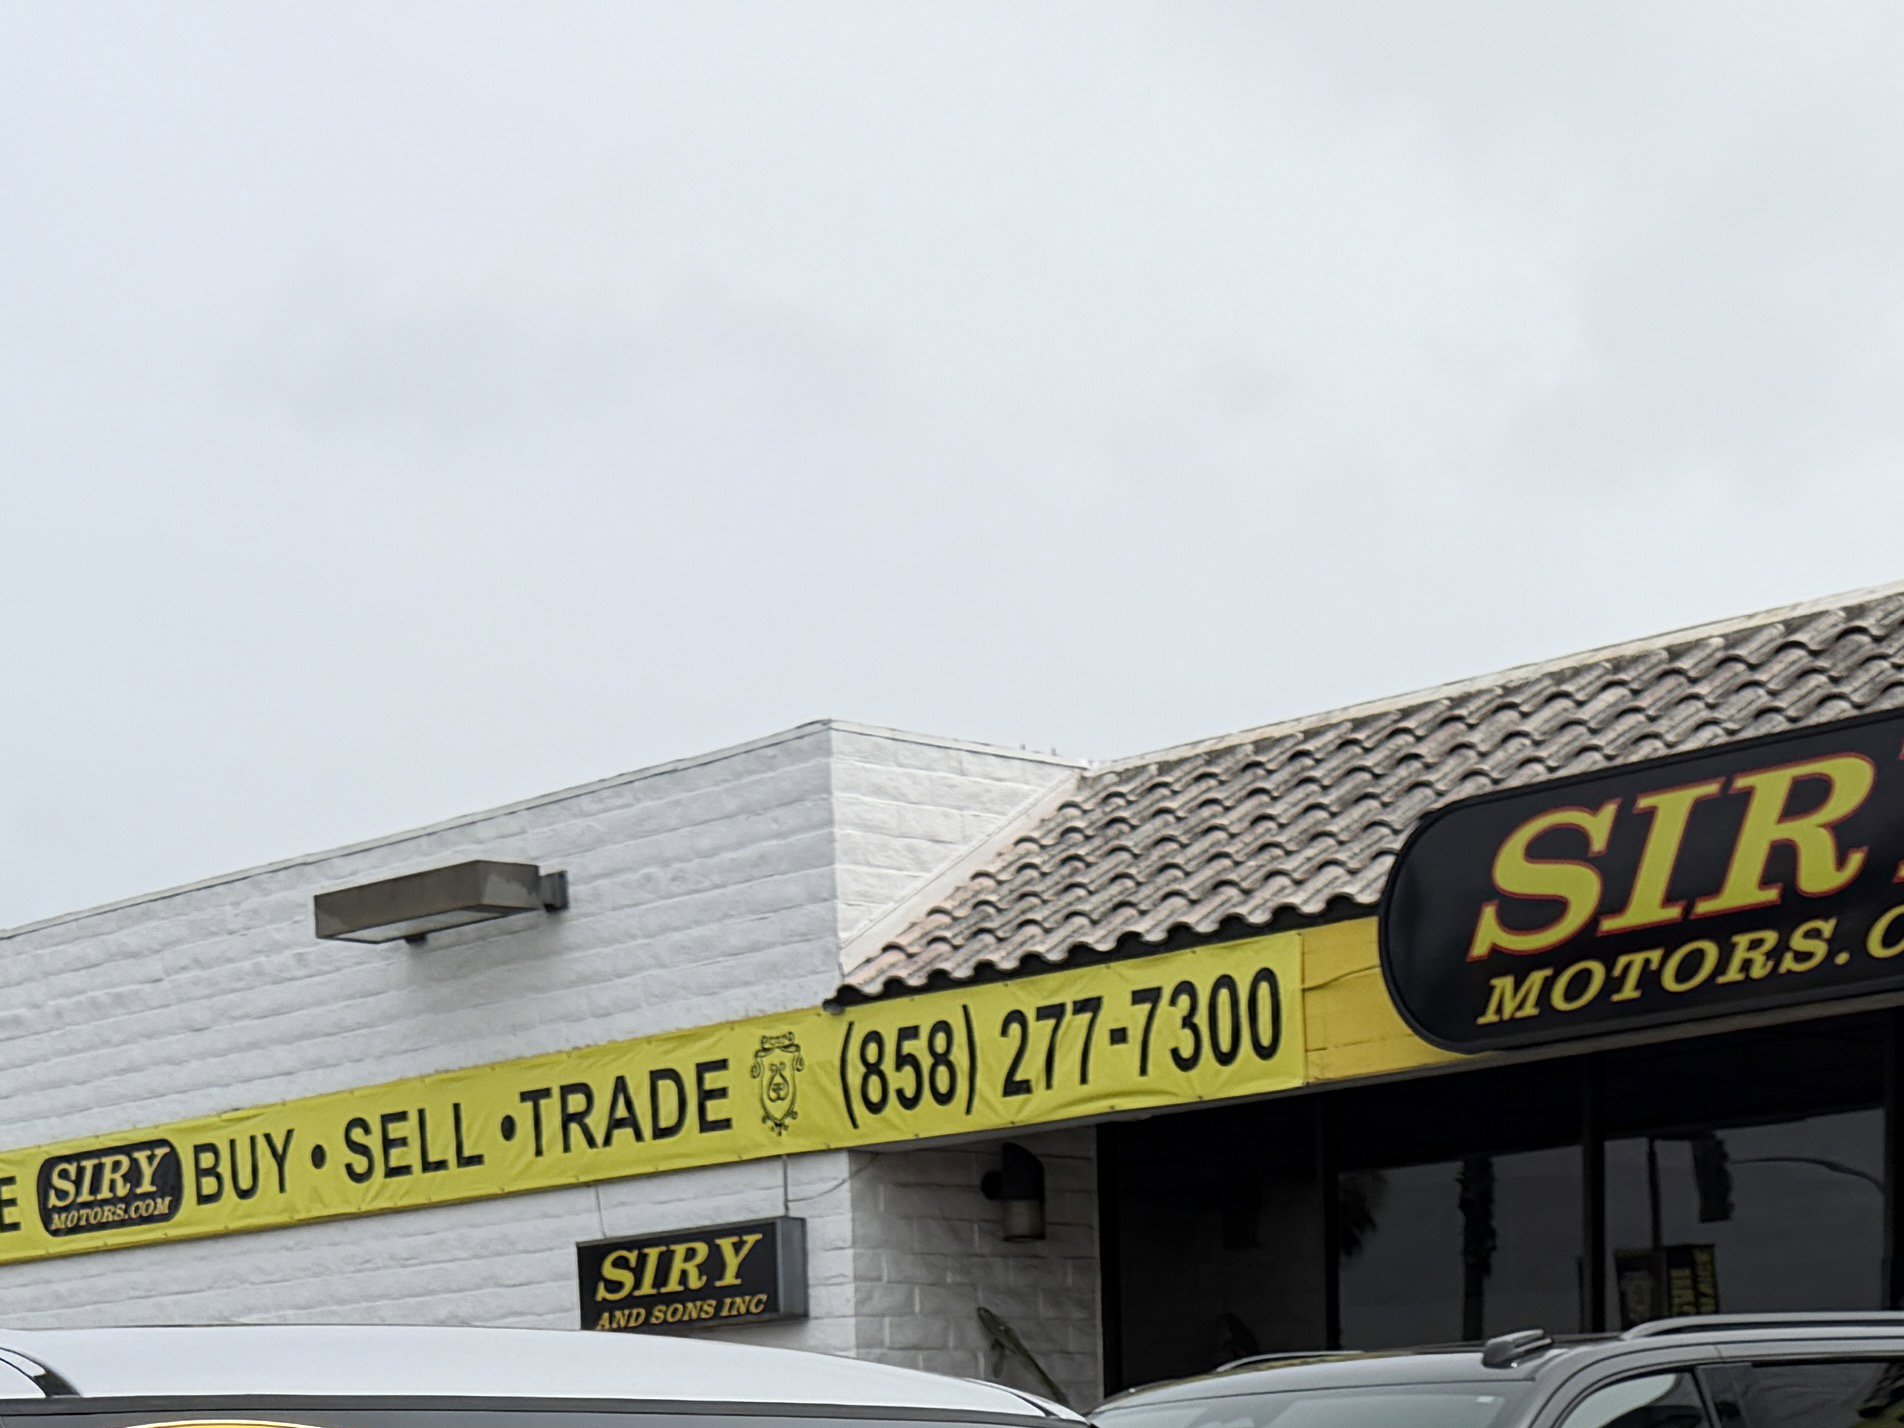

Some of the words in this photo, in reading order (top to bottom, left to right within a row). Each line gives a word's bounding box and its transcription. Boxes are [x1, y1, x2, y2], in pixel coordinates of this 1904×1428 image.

[840, 1004, 976, 1129] (858)
[1001, 967, 1280, 1097] 277-7300
[193, 1128, 295, 1206] BUY
[344, 1102, 484, 1183] SELL
[519, 1059, 732, 1157] TRADE
[48, 1147, 170, 1209] SIRY
[51, 1197, 172, 1229] MOTORS.COM
[596, 1233, 762, 1301] SIRY
[597, 1307, 646, 1330] AND
[651, 1299, 716, 1325] SONS
[720, 1294, 767, 1317] INC
